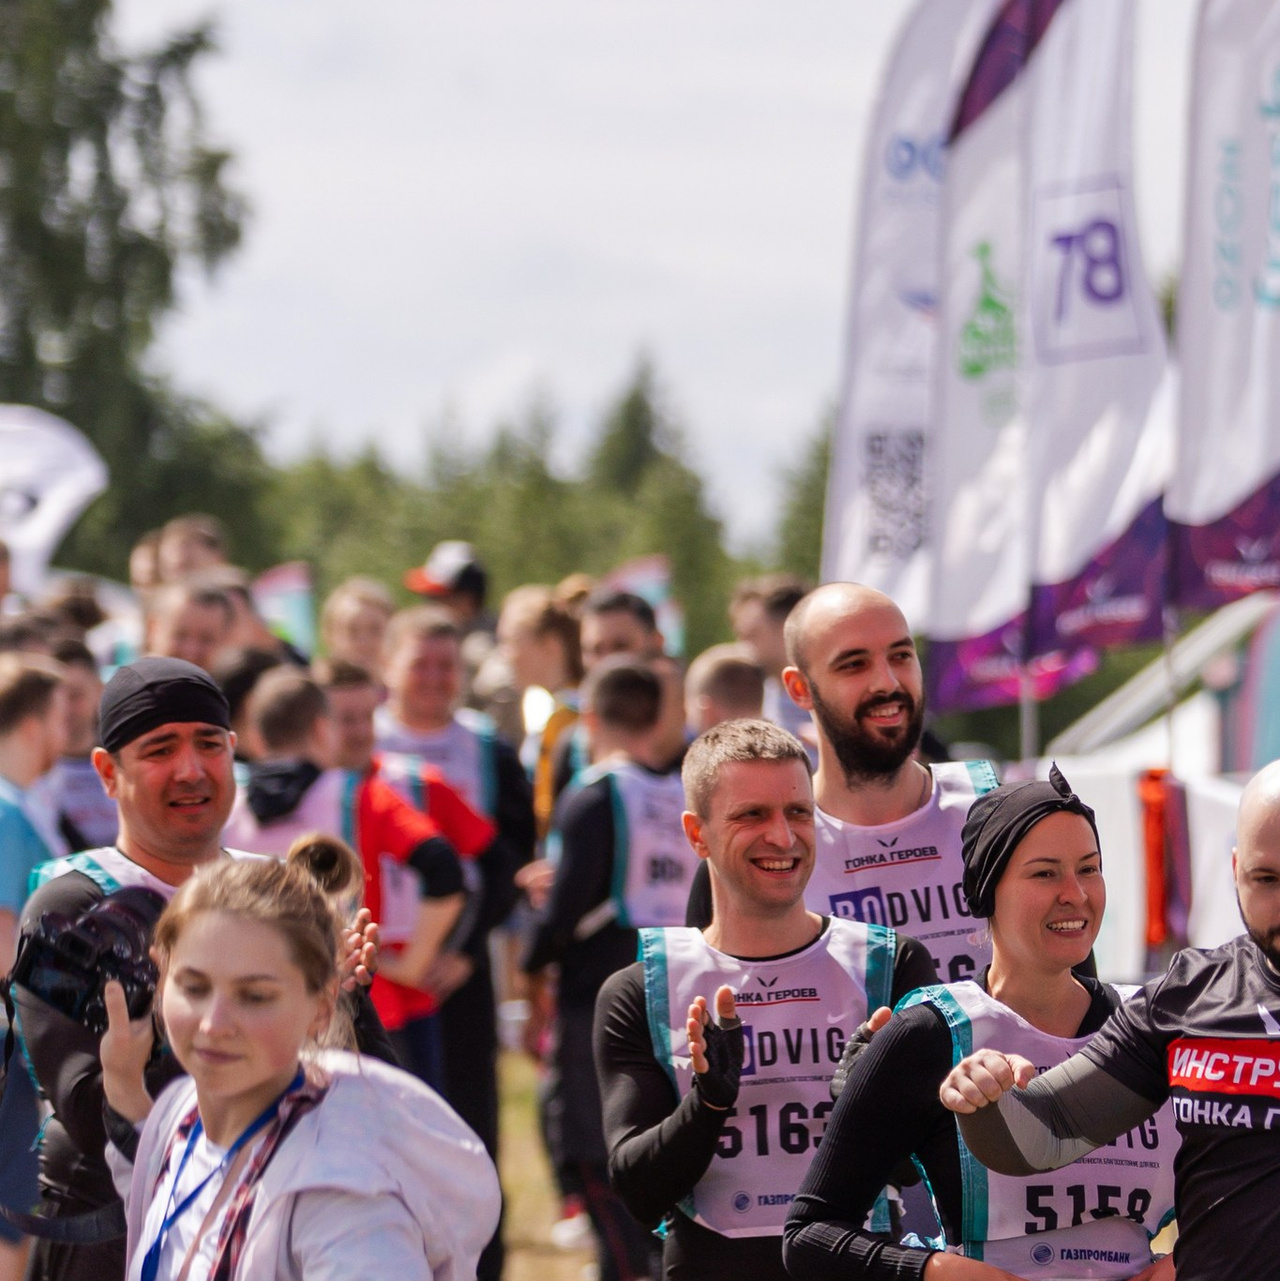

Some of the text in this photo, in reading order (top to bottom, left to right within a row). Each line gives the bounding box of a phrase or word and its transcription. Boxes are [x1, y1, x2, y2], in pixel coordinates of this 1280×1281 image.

[845, 846, 938, 869] ГОНКА ГЕРОЕВ
[767, 988, 818, 1002] ГЕРОЕВ
[1172, 1096, 1253, 1129] ГОНКА
[1060, 1248, 1130, 1264] ГАЗПРОМБАНК
